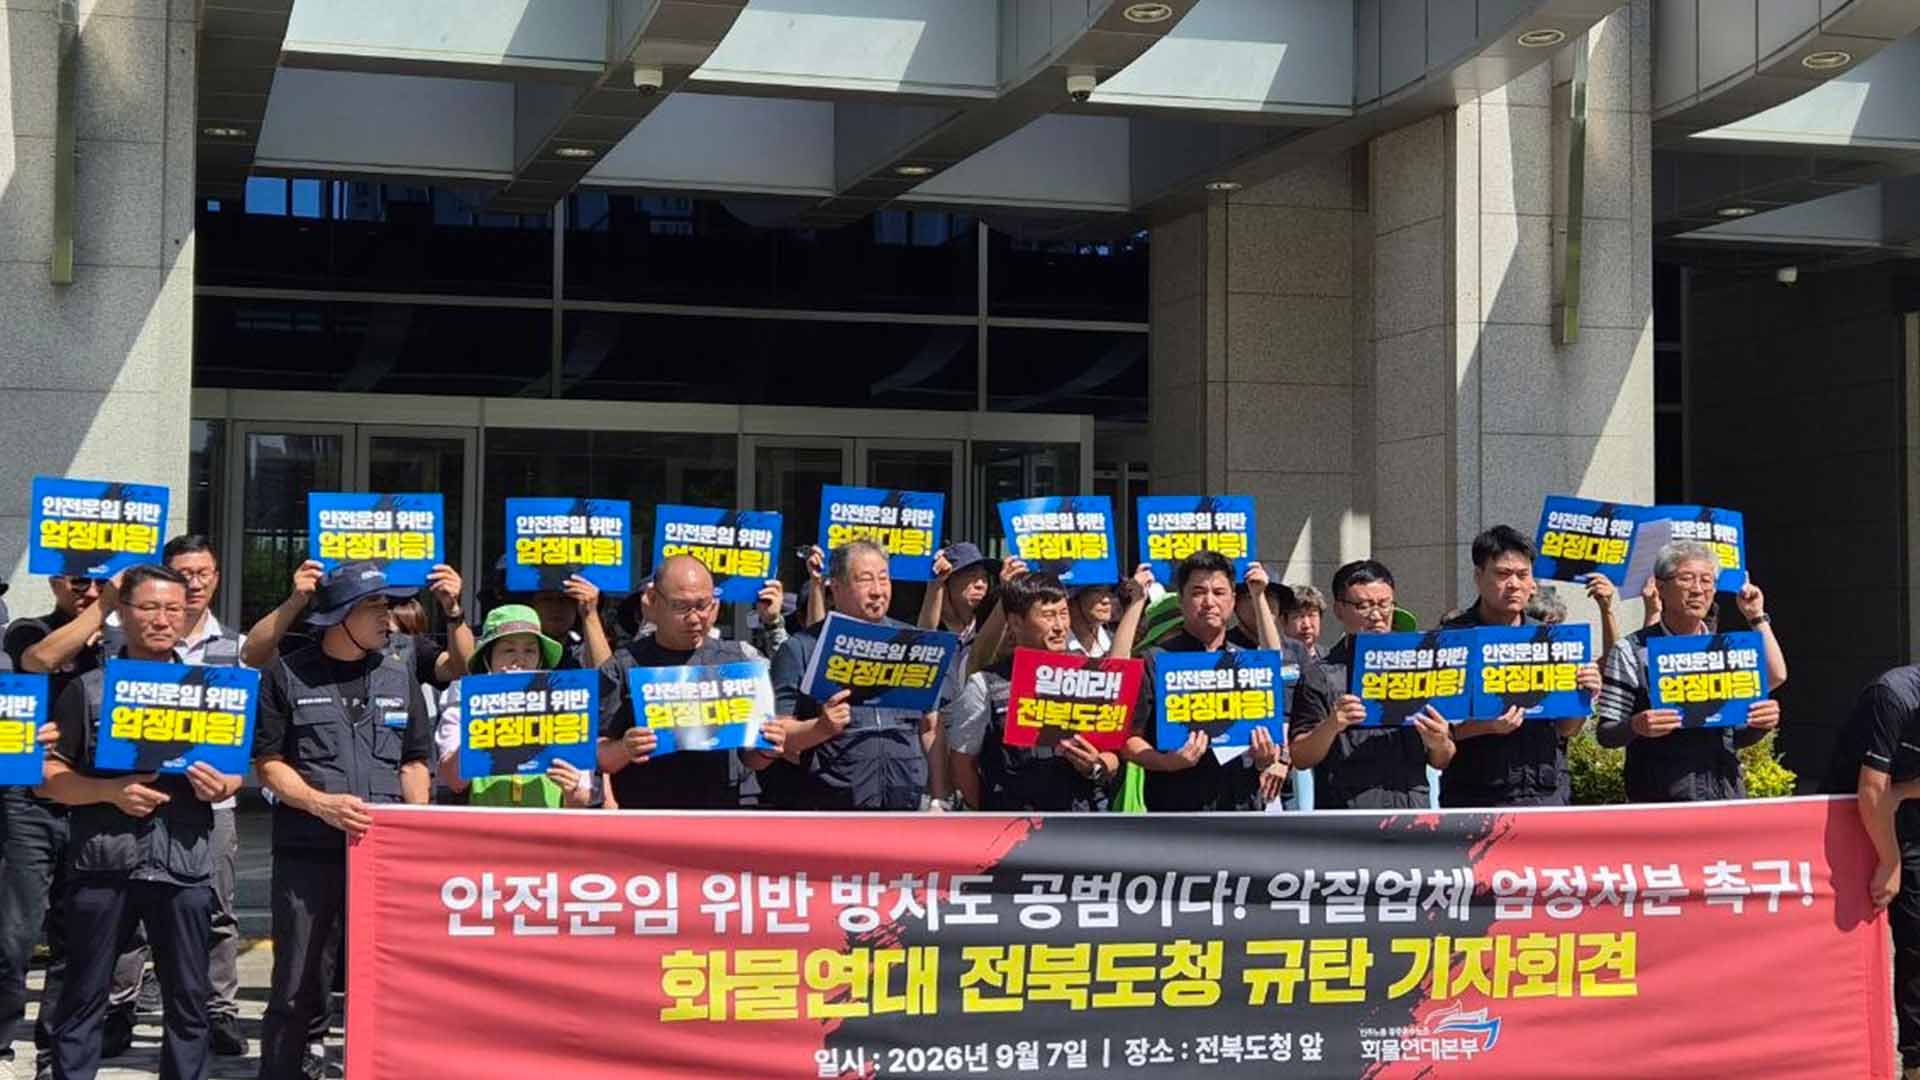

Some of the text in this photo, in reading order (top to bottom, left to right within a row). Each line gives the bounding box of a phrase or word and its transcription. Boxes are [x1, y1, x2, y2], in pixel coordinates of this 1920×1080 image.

[42, 496, 161, 522] 안전운임 위반
[319, 511, 434, 530] 안전운임 위반
[830, 503, 934, 527] 안전운임 위반
[1012, 513, 1105, 531] 안전운임 위반
[1147, 513, 1246, 531] 안전운임 위반
[40, 520, 157, 554] 엄정대응!
[516, 516, 622, 536] 안전운임 위반
[665, 523, 772, 548] 안전운임 위반
[1547, 511, 1634, 537] 안전운임 위반
[1671, 521, 1711, 541] 전운임
[319, 532, 434, 560] 엄정대응!
[516, 537, 622, 566] 엄정대응!
[1017, 533, 1108, 560] 엄정대응!
[1541, 531, 1630, 565] 엄정대응!
[834, 635, 945, 662] 안전운임 위반
[1364, 646, 1469, 668] 안전운임 위반
[1482, 641, 1584, 663] 안전운임 위반
[1657, 648, 1757, 672] 안전운임 위반
[825, 656, 938, 688] 엄정대응!
[1035, 664, 1122, 699] 일해라!
[1165, 668, 1273, 690] 안전운임 위반
[1361, 668, 1466, 700] 엄정대응!
[115, 681, 249, 712] 안전운임 위반
[1658, 671, 1760, 703] 엄정대응!
[469, 689, 589, 714] 안전운임 위반
[645, 697, 753, 729] 엄정대응
[1016, 697, 1128, 733] 전북도청!
[1166, 691, 1273, 721] 엄정대응!
[110, 706, 245, 747] 엄정대응!
[468, 714, 588, 748] 엄정대응!
[441, 860, 1814, 936] 안전운임 위반 방치도 공범이다! 악질업체 엄정처분 촉구!
[659, 930, 1640, 1023] 화물연대 전북도청 규탄 기자회견
[814, 1046, 865, 1078] 일시
[888, 1042, 989, 1073] 2026년
[994, 1040, 1040, 1071] 9월
[1045, 1038, 1088, 1069] 7일
[1124, 1037, 1176, 1068] 장소
[1194, 1032, 1293, 1065] 전북도청
[1298, 1032, 1325, 1062] 앞
